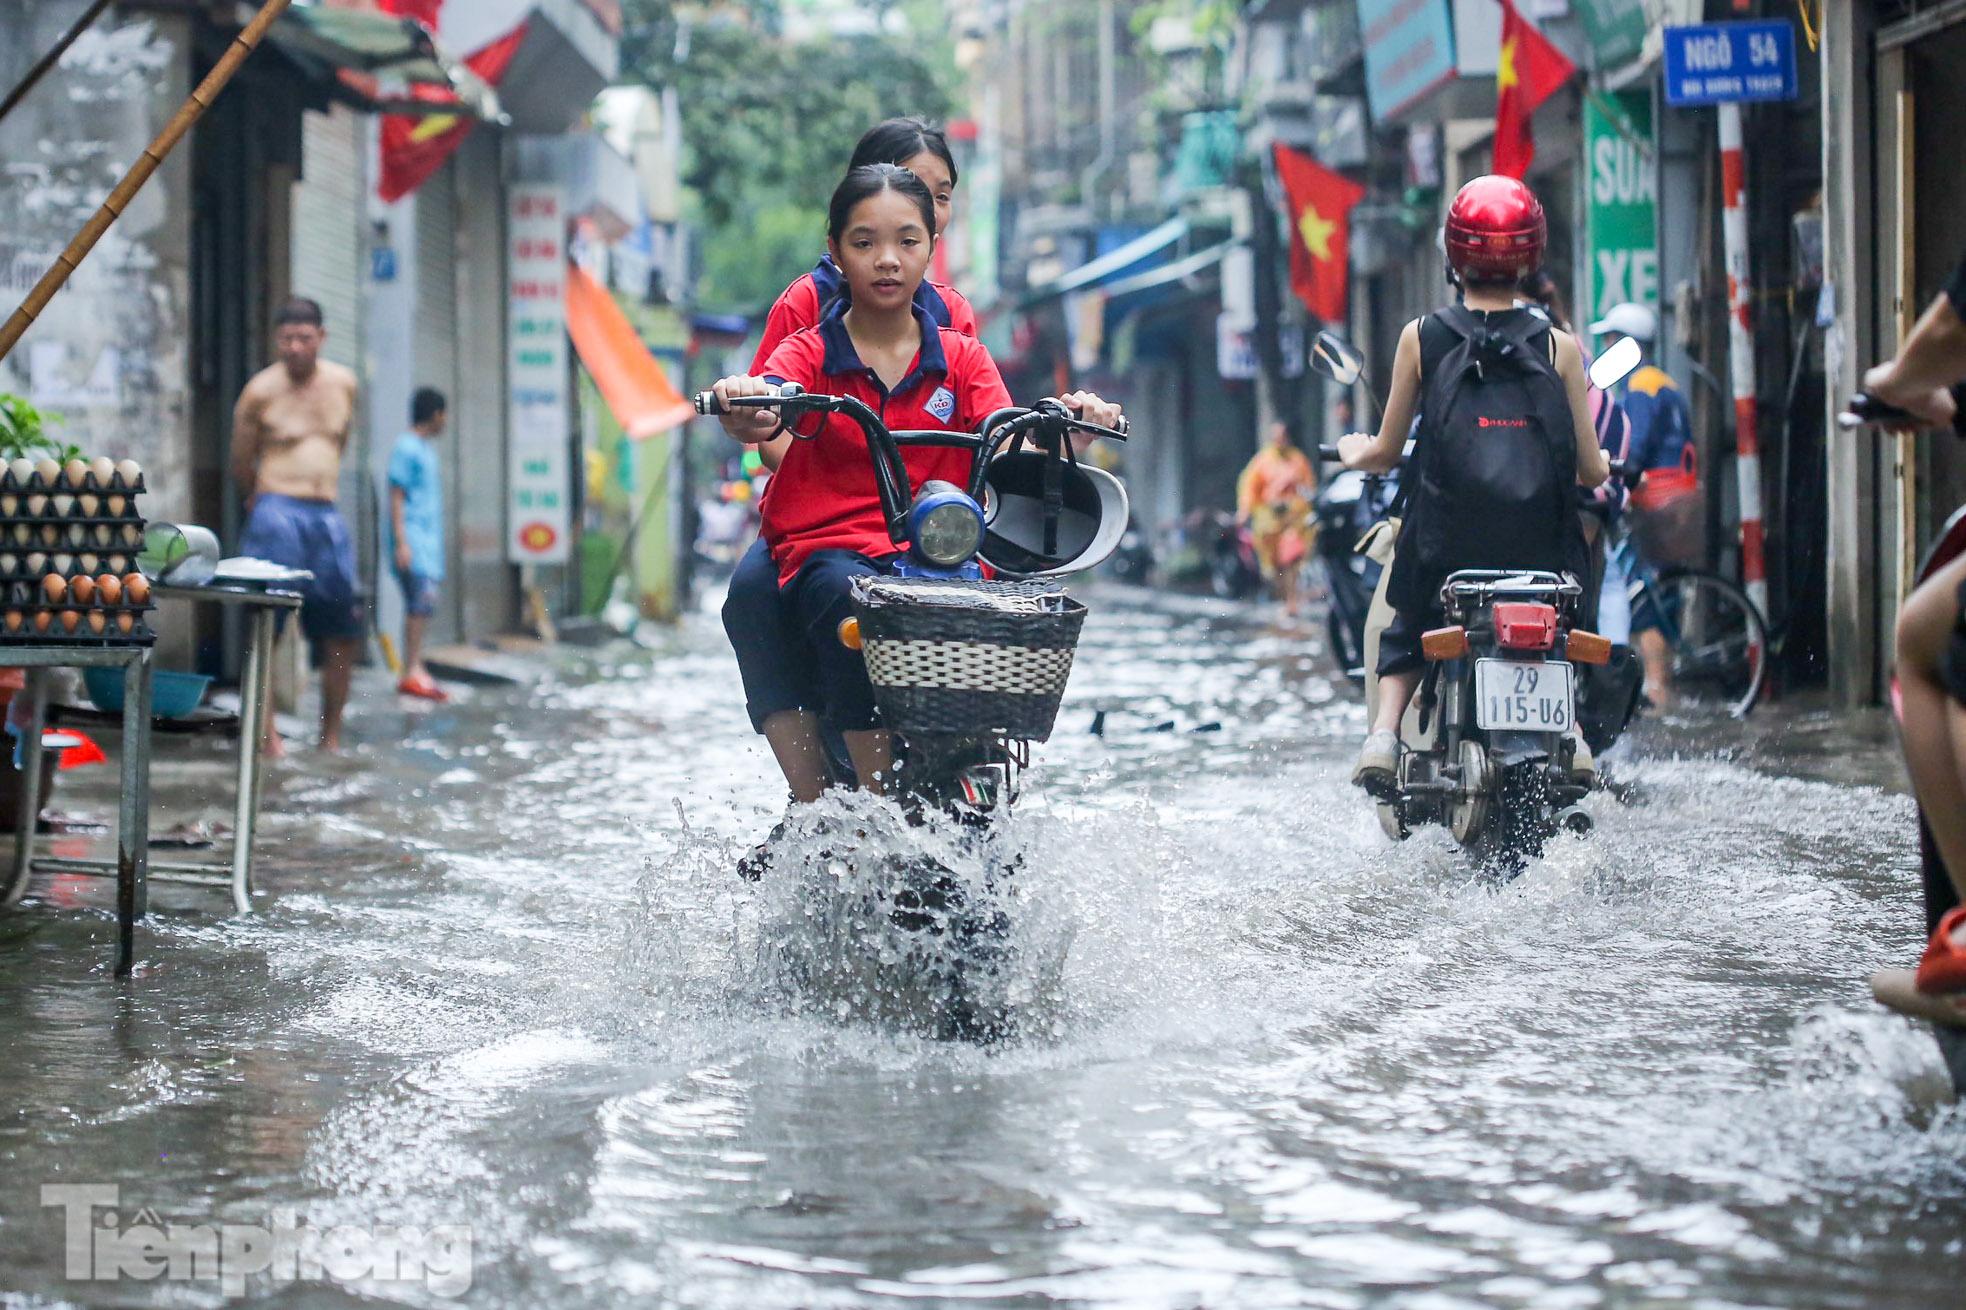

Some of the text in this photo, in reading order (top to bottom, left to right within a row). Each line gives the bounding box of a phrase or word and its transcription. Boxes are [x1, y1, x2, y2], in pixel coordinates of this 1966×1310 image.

[1748, 31, 1779, 67] 54
[1596, 249, 1658, 317] XE
[1513, 666, 1539, 694] 29
[1491, 696, 1565, 725] 115-U6
